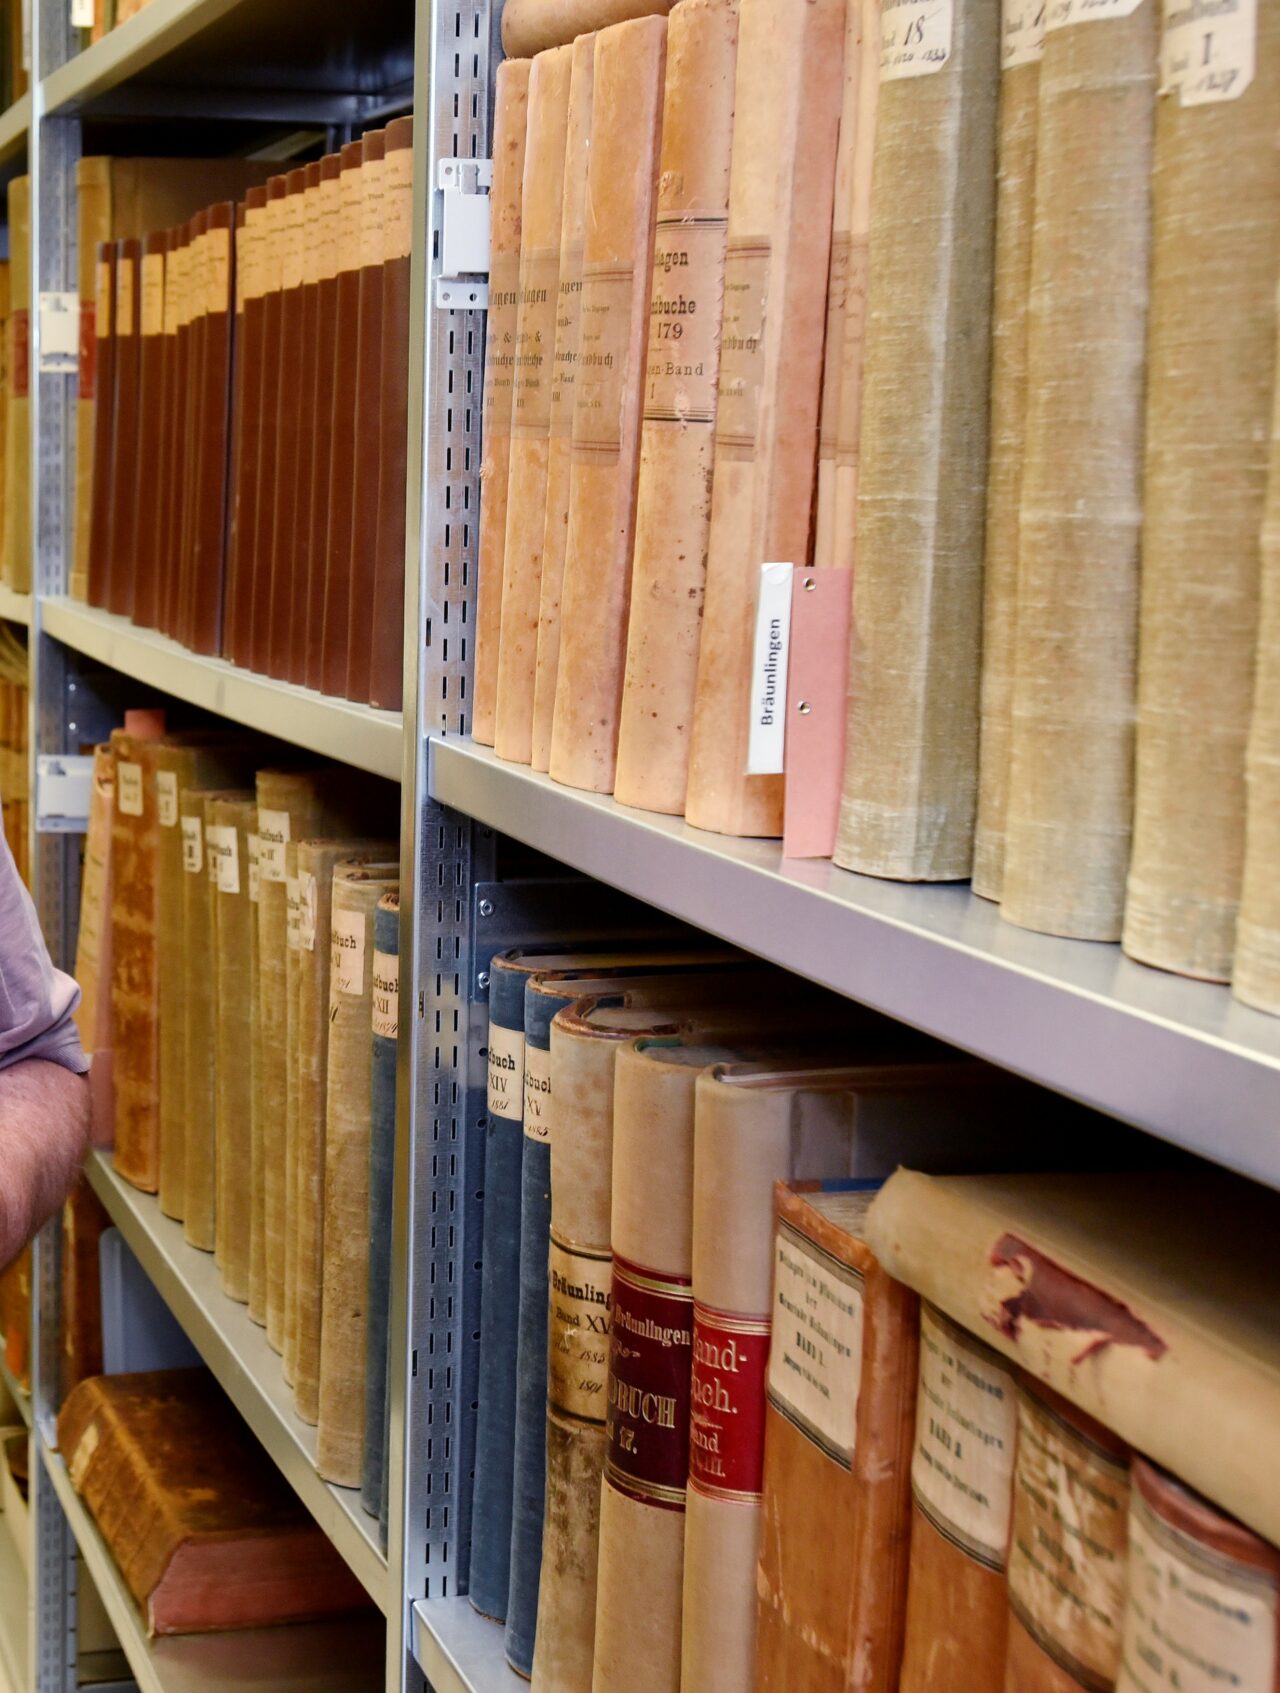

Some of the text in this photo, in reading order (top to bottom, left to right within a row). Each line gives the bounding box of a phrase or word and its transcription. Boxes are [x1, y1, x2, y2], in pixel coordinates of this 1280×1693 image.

[760, 618, 782, 726] Bräunlingen
[488, 1072, 508, 1094] XIV
[614, 1303, 691, 1348] Bräunlingen
